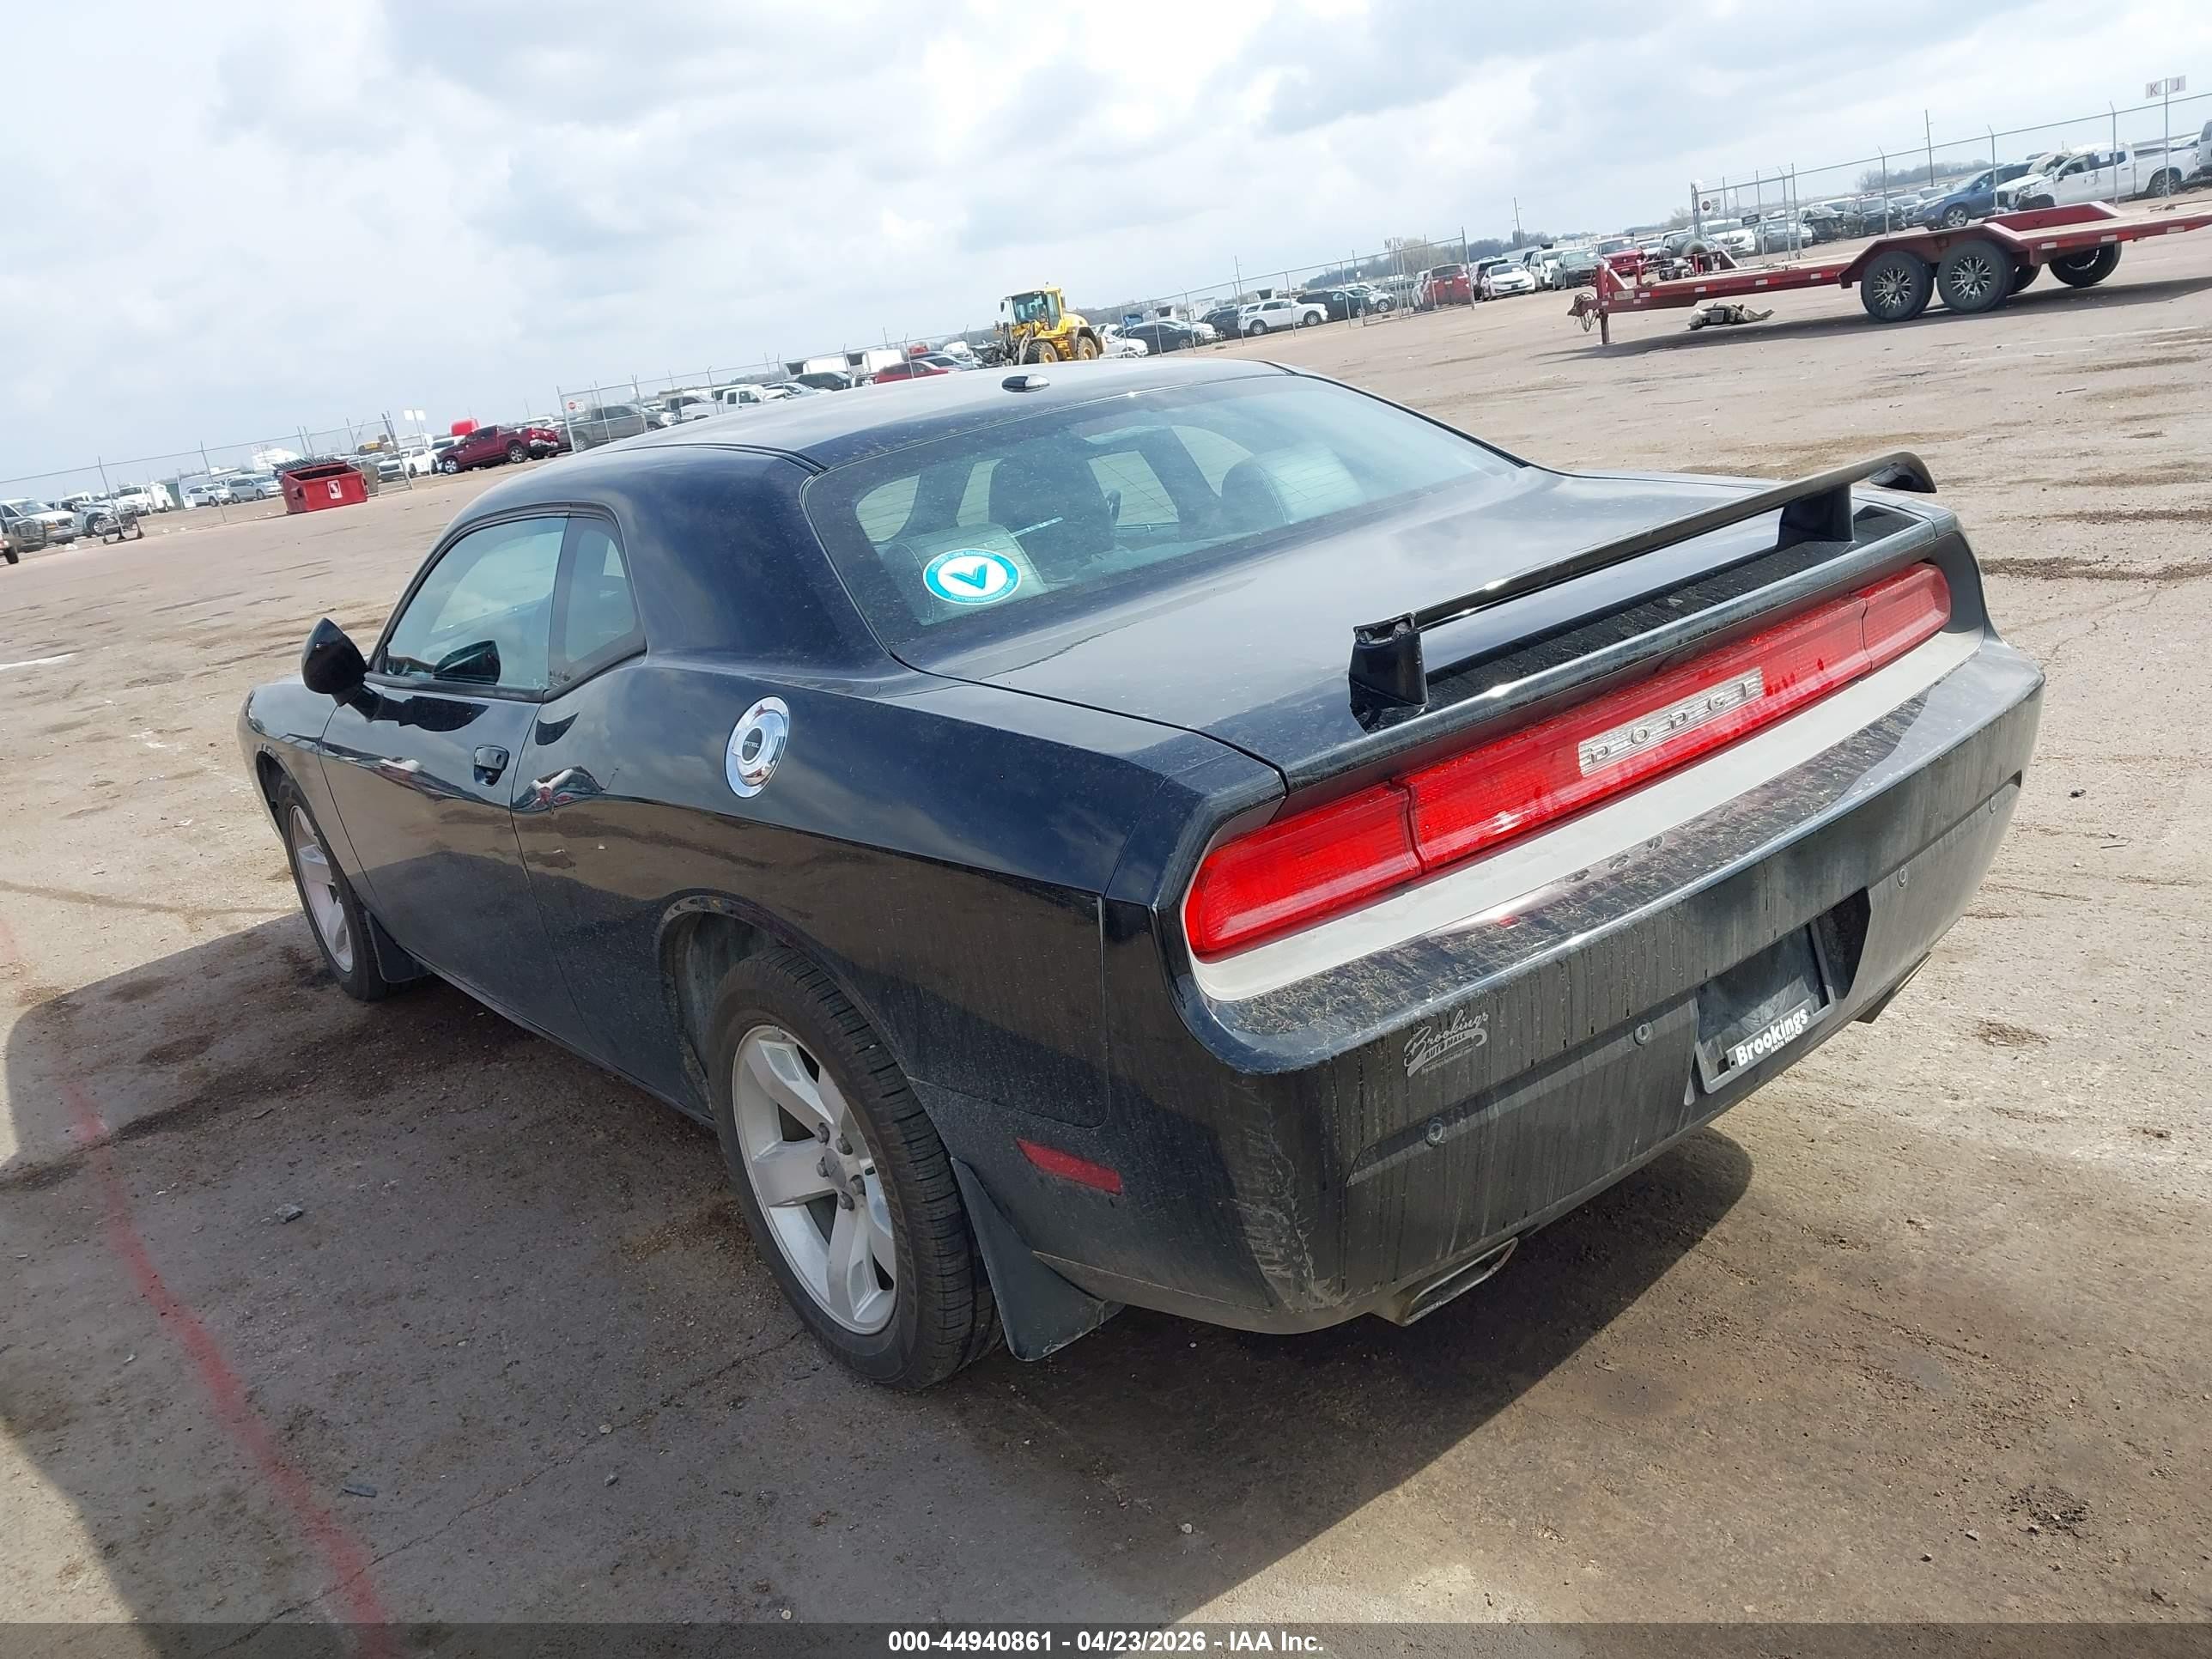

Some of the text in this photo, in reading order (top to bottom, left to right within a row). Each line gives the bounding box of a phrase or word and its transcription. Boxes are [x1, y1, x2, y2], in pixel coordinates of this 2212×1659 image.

[2149, 82, 2158, 96] K
[1587, 677, 1759, 764] DODGE
[1404, 1009, 1489, 1060] Brookings
[1735, 1009, 1808, 1067] Brookings
